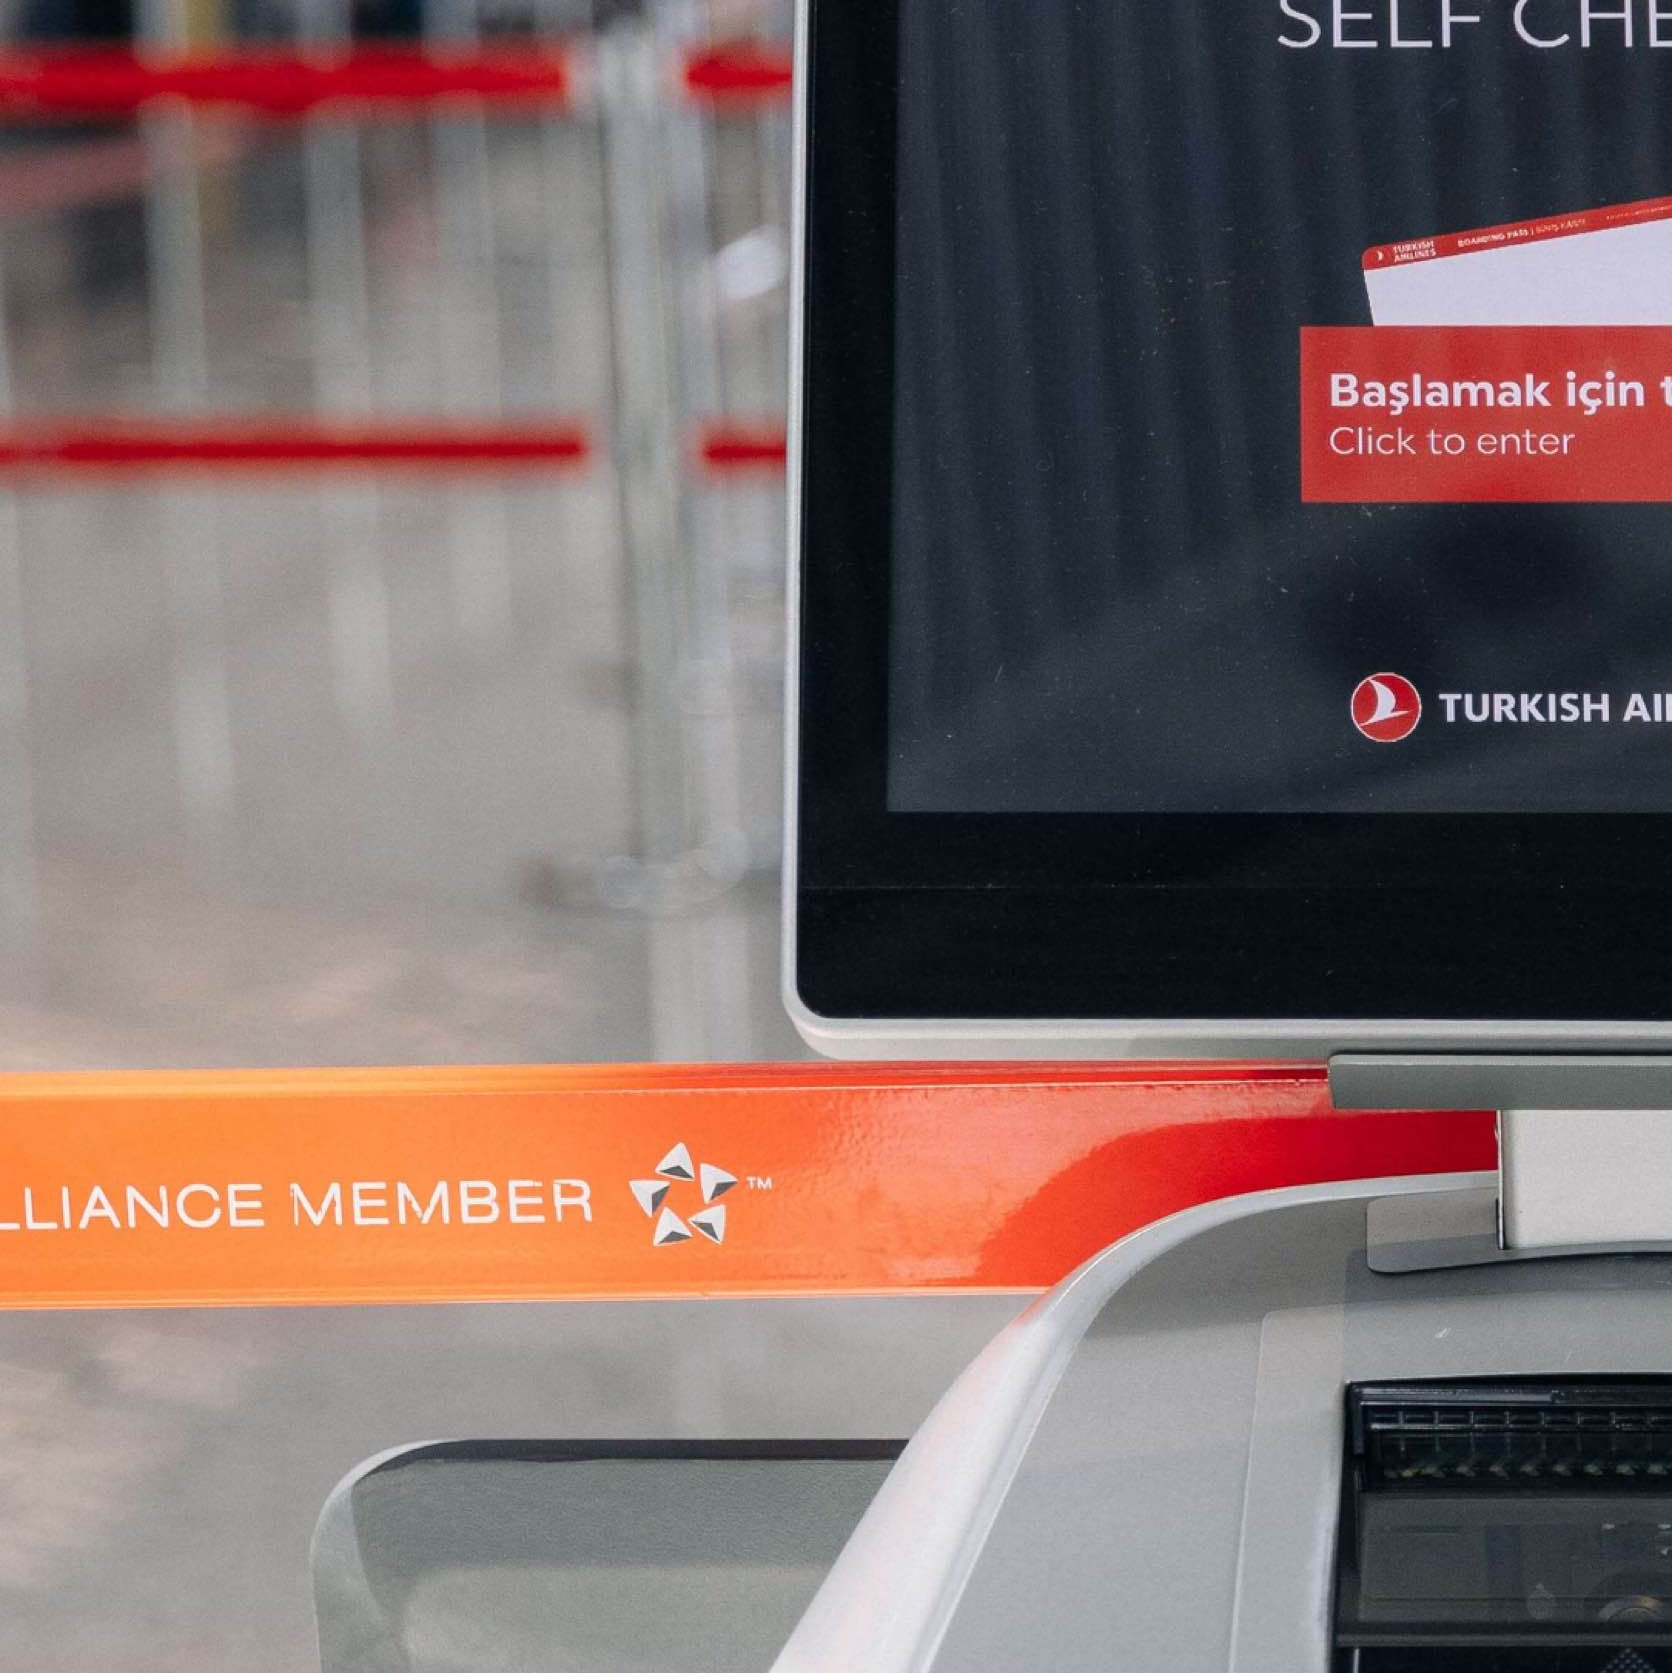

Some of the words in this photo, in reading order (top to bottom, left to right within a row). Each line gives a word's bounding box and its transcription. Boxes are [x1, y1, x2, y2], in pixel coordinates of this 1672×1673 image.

[1330, 373, 1552, 416] Başlamak
[1566, 370, 1645, 416] için
[1329, 426, 1416, 455] Click
[1427, 429, 1465, 455] to
[1477, 429, 1576, 455] enter
[1438, 693, 1610, 723] TURKISH
[289, 1178, 593, 1226] MEMBER
